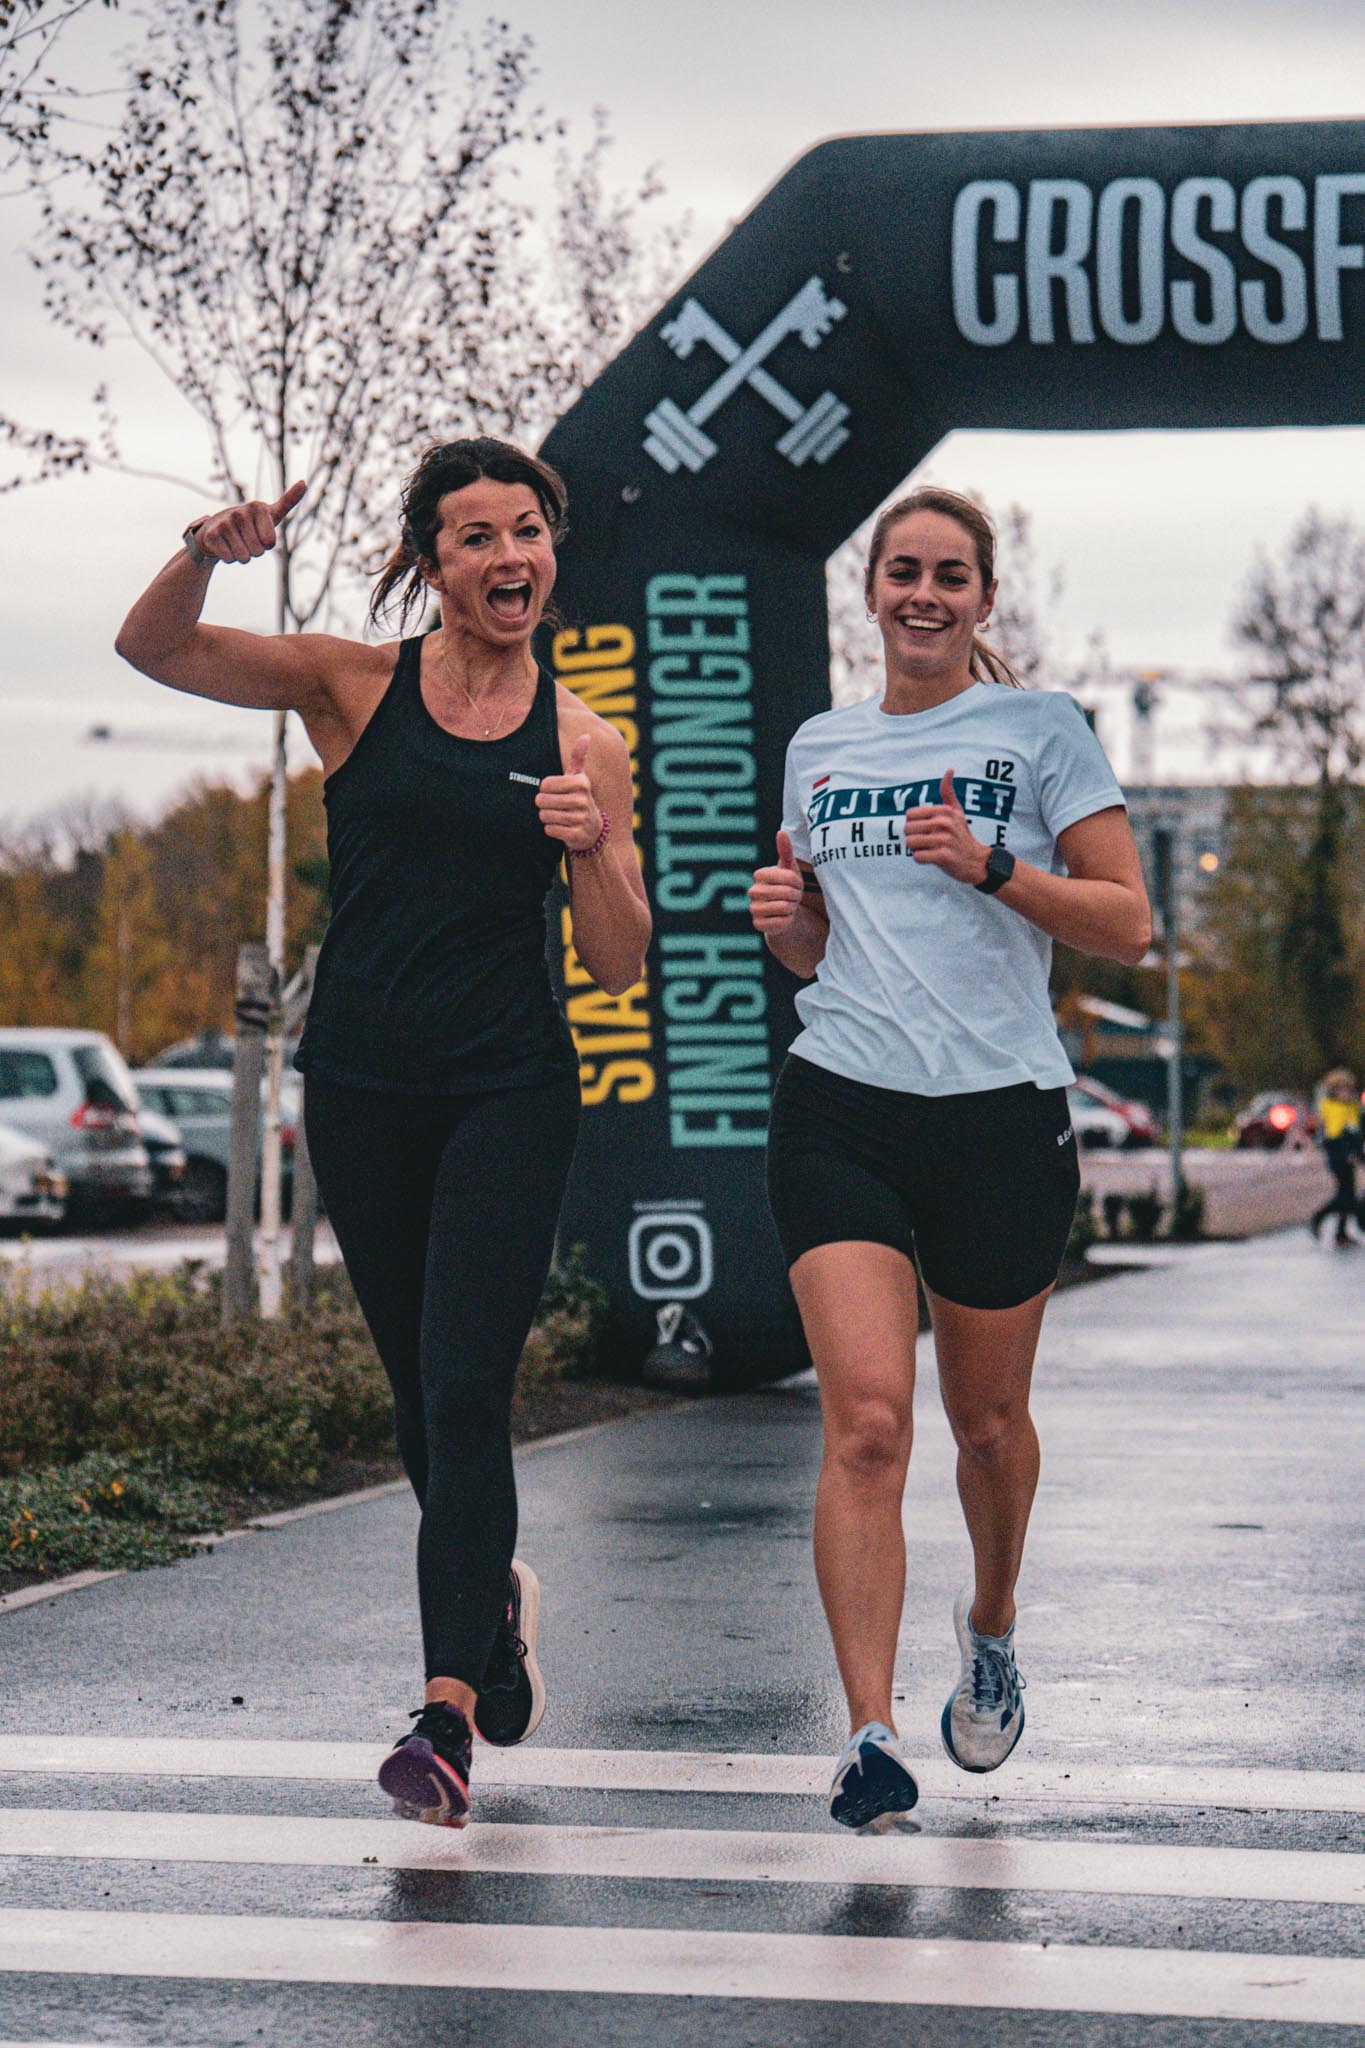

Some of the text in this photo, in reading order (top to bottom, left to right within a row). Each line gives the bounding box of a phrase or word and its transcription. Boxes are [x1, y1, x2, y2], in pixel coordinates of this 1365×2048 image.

[951, 174, 1365, 347] CROSSF
[645, 571, 764, 916] STRONGER
[985, 759, 1014, 783] 02
[854, 843, 902, 858] LEIDEN
[660, 932, 772, 1149] FINISH
